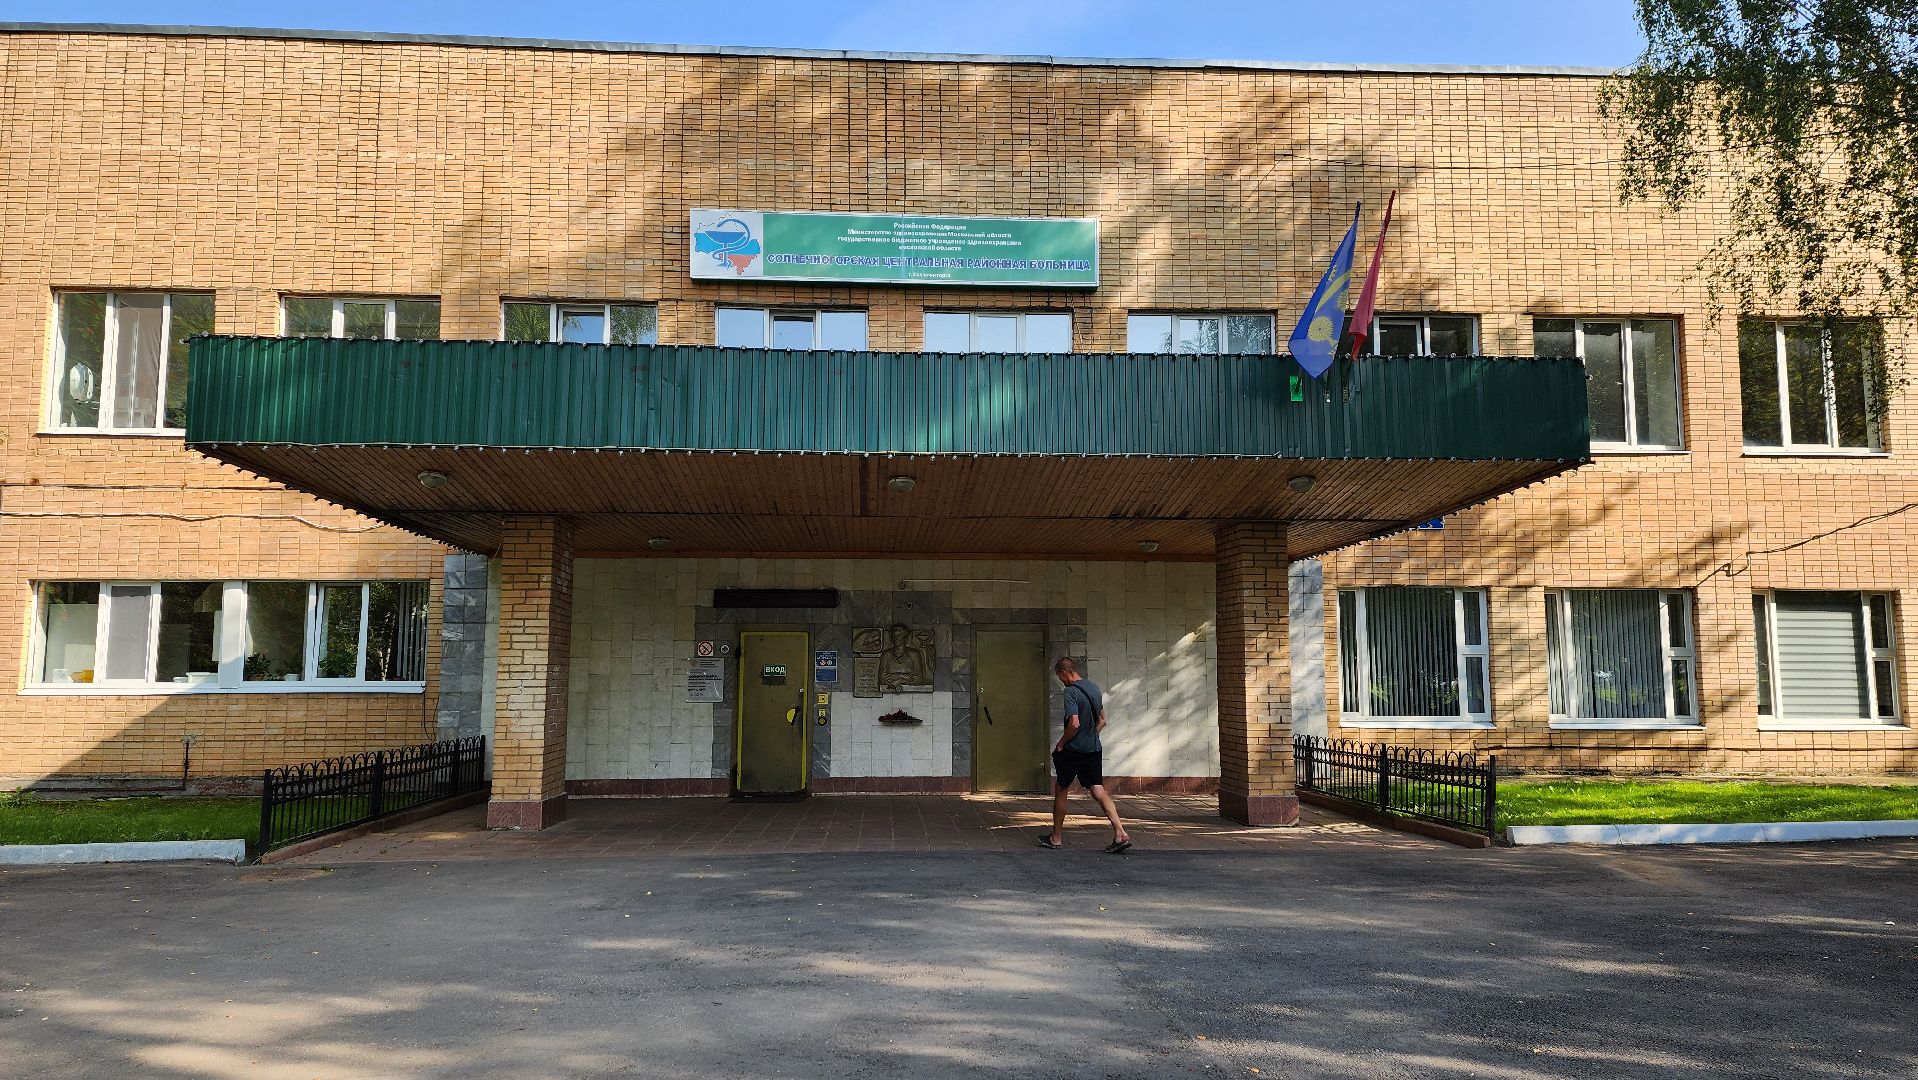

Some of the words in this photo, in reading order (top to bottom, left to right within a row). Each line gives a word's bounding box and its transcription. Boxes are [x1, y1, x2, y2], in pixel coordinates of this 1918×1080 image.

[767, 254, 879, 266] СОЛНЕЧНОГОРСКАЯ
[882, 257, 964, 268] ЦЕНТРАЛЬНАЯ
[966, 257, 1028, 270] РАЙОННАЯ
[1029, 259, 1091, 271] БОЛЬНИЦА
